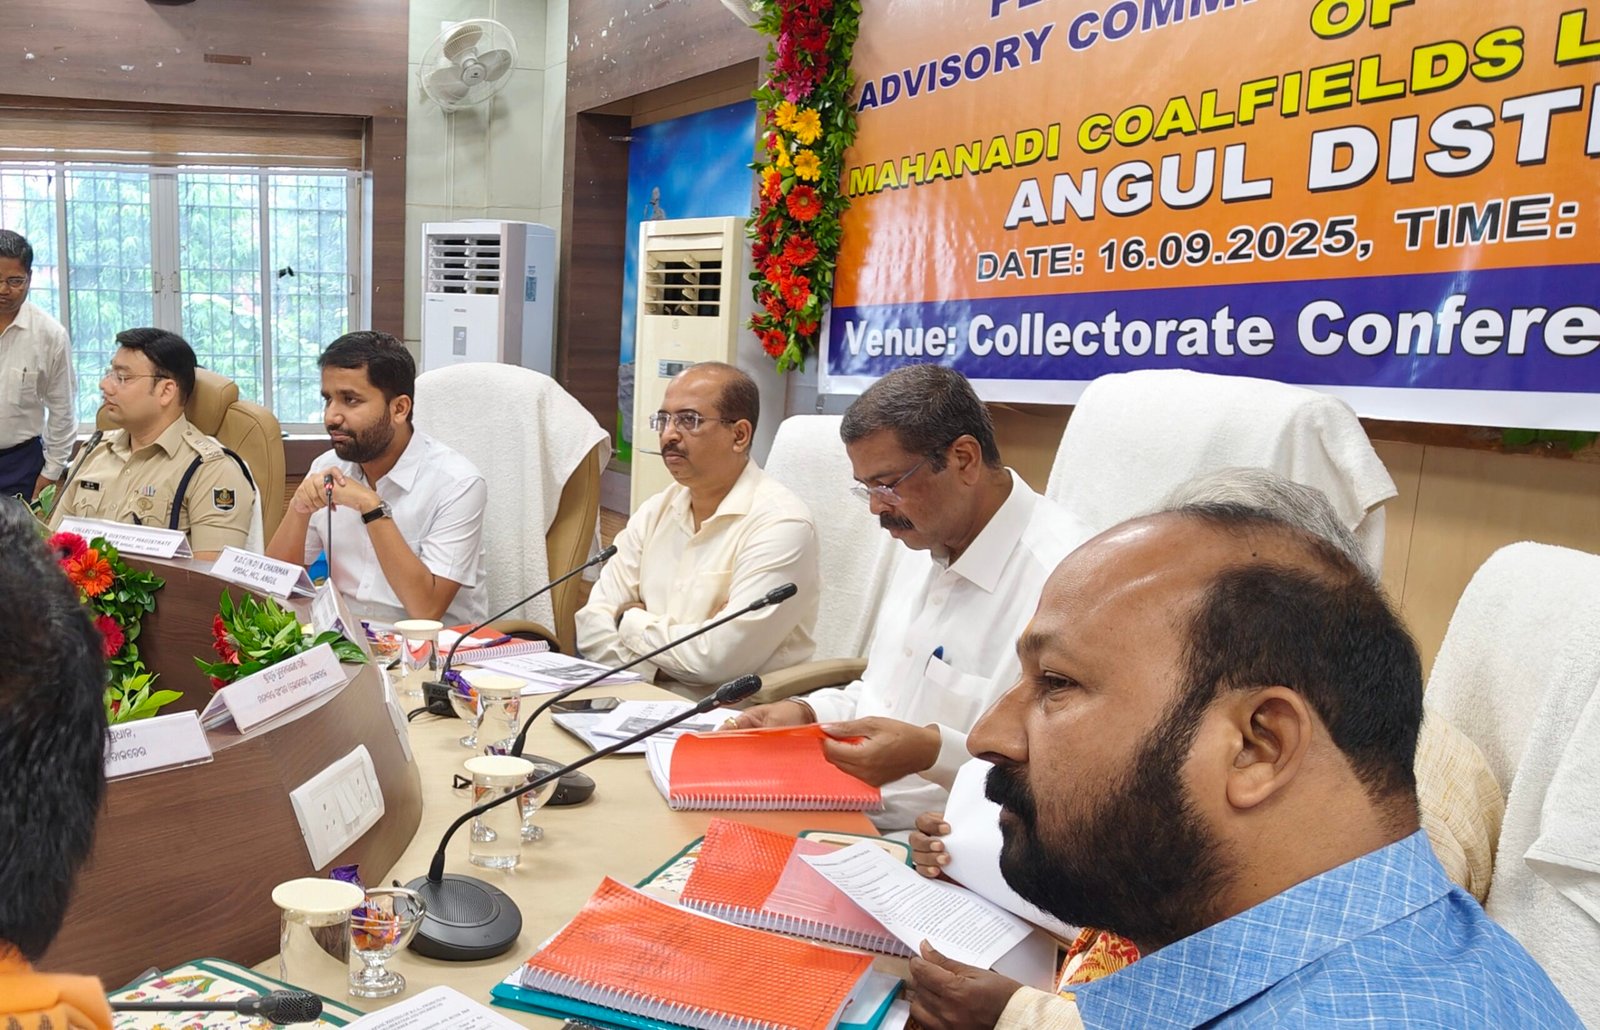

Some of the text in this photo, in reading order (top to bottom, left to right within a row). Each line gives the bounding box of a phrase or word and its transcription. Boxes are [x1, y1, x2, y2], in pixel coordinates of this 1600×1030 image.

[849, 122, 1061, 198] MAHANADI
[1077, 26, 1525, 152] COALFIELDS
[857, 24, 1055, 112] ADVISORY
[1003, 142, 1273, 230] ANGUL
[976, 194, 1579, 282] DATE: 16.09.2025, TIME:
[844, 294, 1600, 358] Venue: Collectorate Confere
